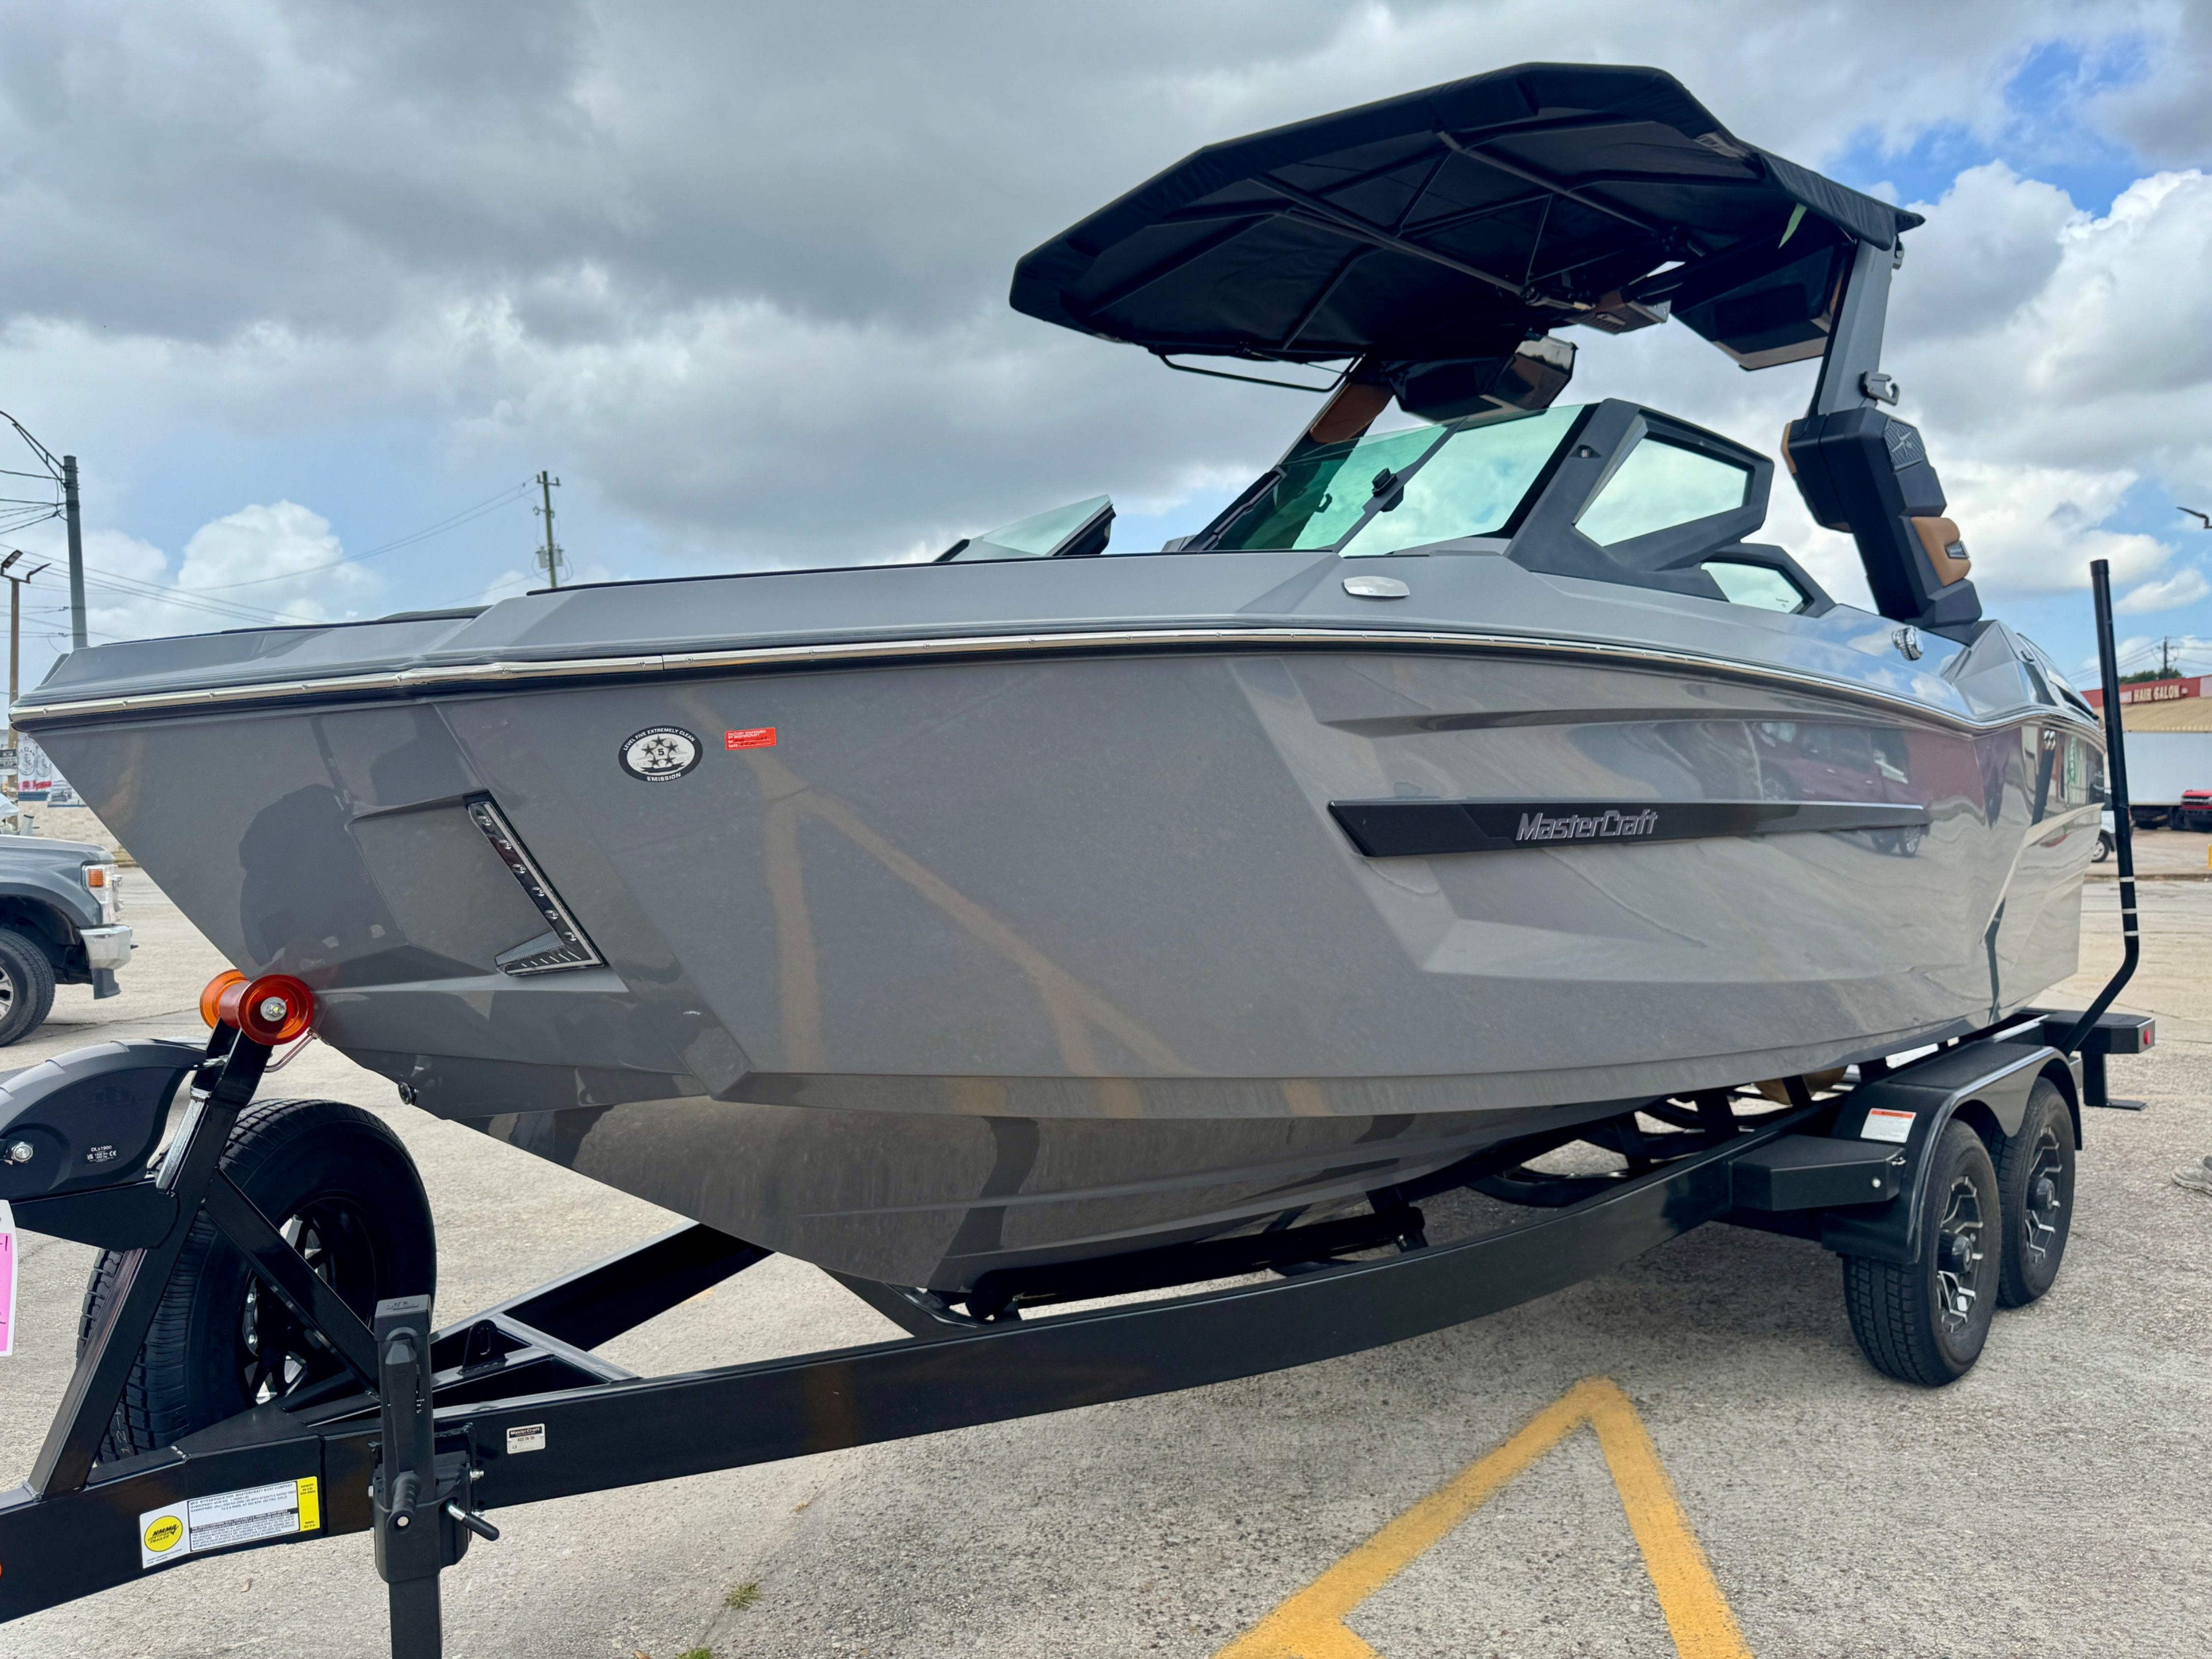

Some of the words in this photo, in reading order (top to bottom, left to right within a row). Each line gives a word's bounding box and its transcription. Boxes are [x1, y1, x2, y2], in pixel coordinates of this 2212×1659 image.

[2133, 687, 2152, 702] HAIR
[2154, 684, 2180, 700] SALON
[623, 738, 636, 751] LEVEL
[679, 730, 695, 742] CLEAN
[647, 773, 681, 782] EMISSION
[1516, 809, 1659, 841] MasterCraft
